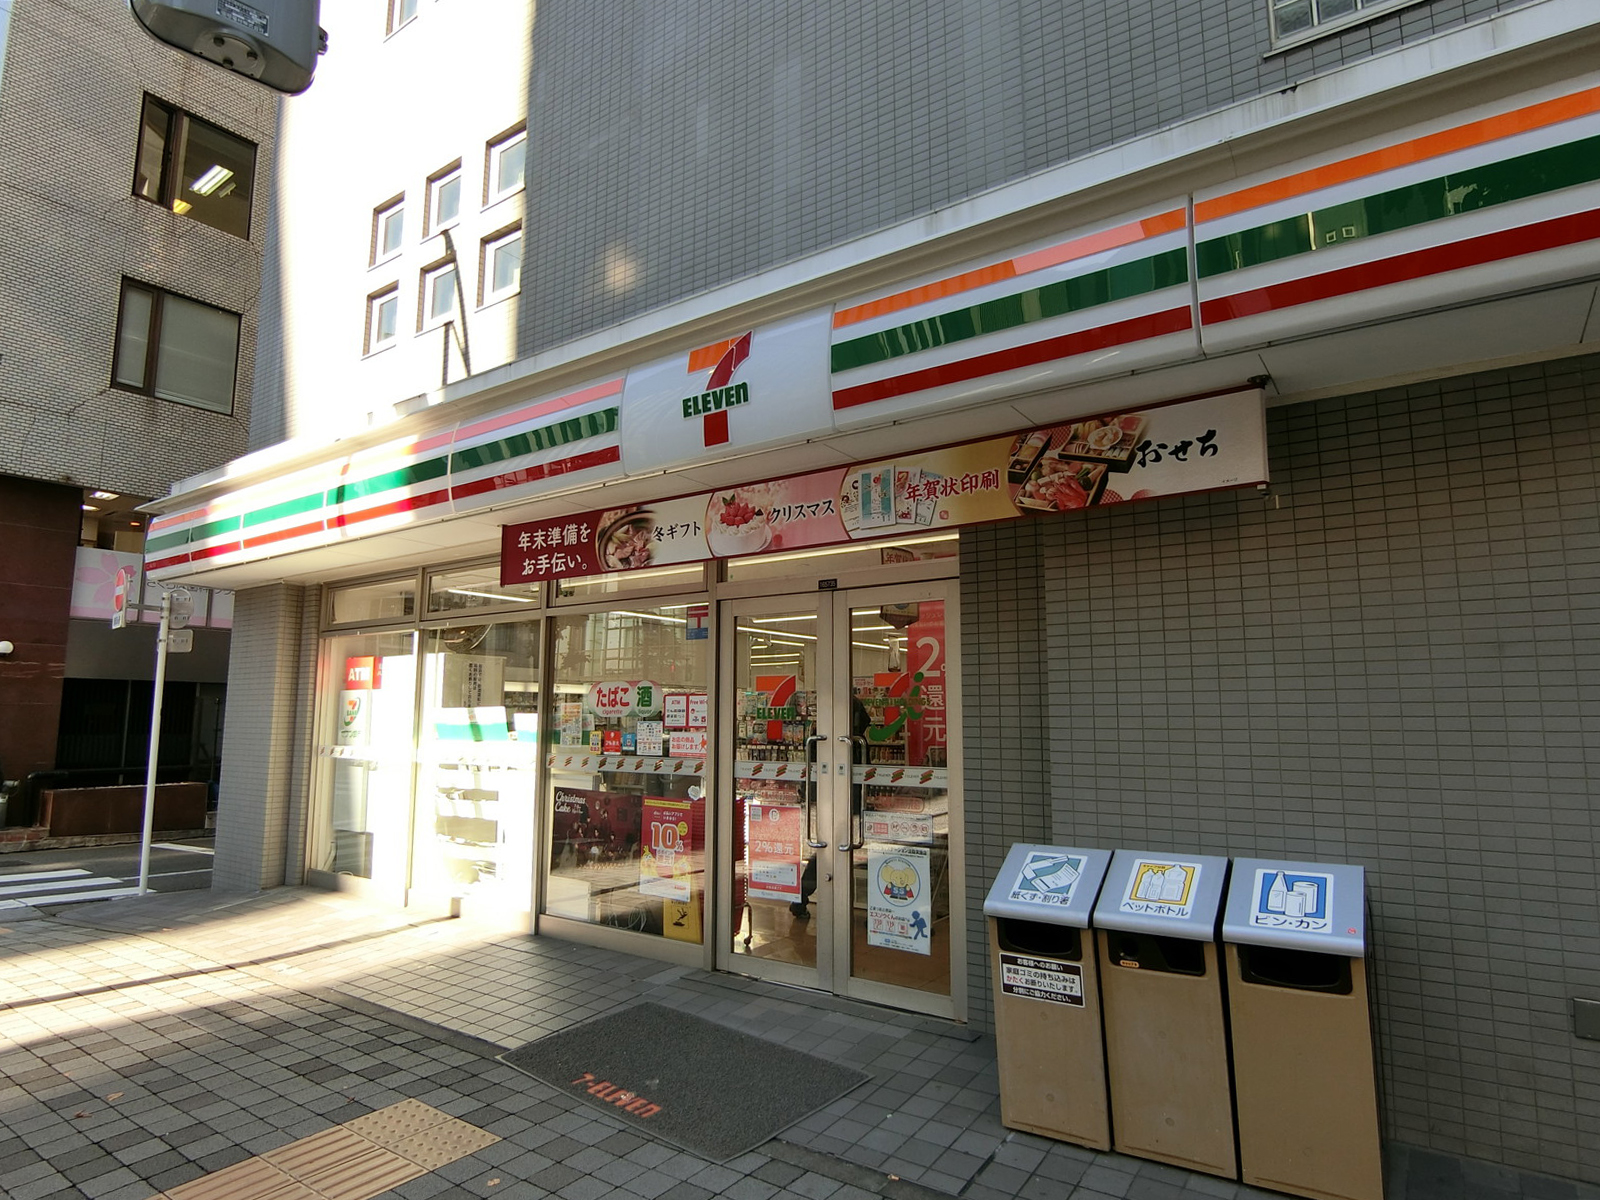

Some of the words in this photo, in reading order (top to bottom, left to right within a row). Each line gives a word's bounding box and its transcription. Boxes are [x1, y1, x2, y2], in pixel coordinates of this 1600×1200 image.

[1136, 429, 1220, 469] おせち
[904, 468, 1000, 503] 年賀状印刷
[769, 499, 836, 523] クリスマス
[517, 522, 592, 552] 年末準備を
[652, 520, 701, 543] 冬ギフト
[521, 553, 588, 576] お手伝い。
[596, 686, 630, 708] たばこ
[637, 686, 653, 707] 酒
[1122, 902, 1189, 917] ペットボトル
[1006, 966, 1076, 985] 家庭ゴミの持ち込みは
[1016, 958, 1064, 971] お客様へのお願い
